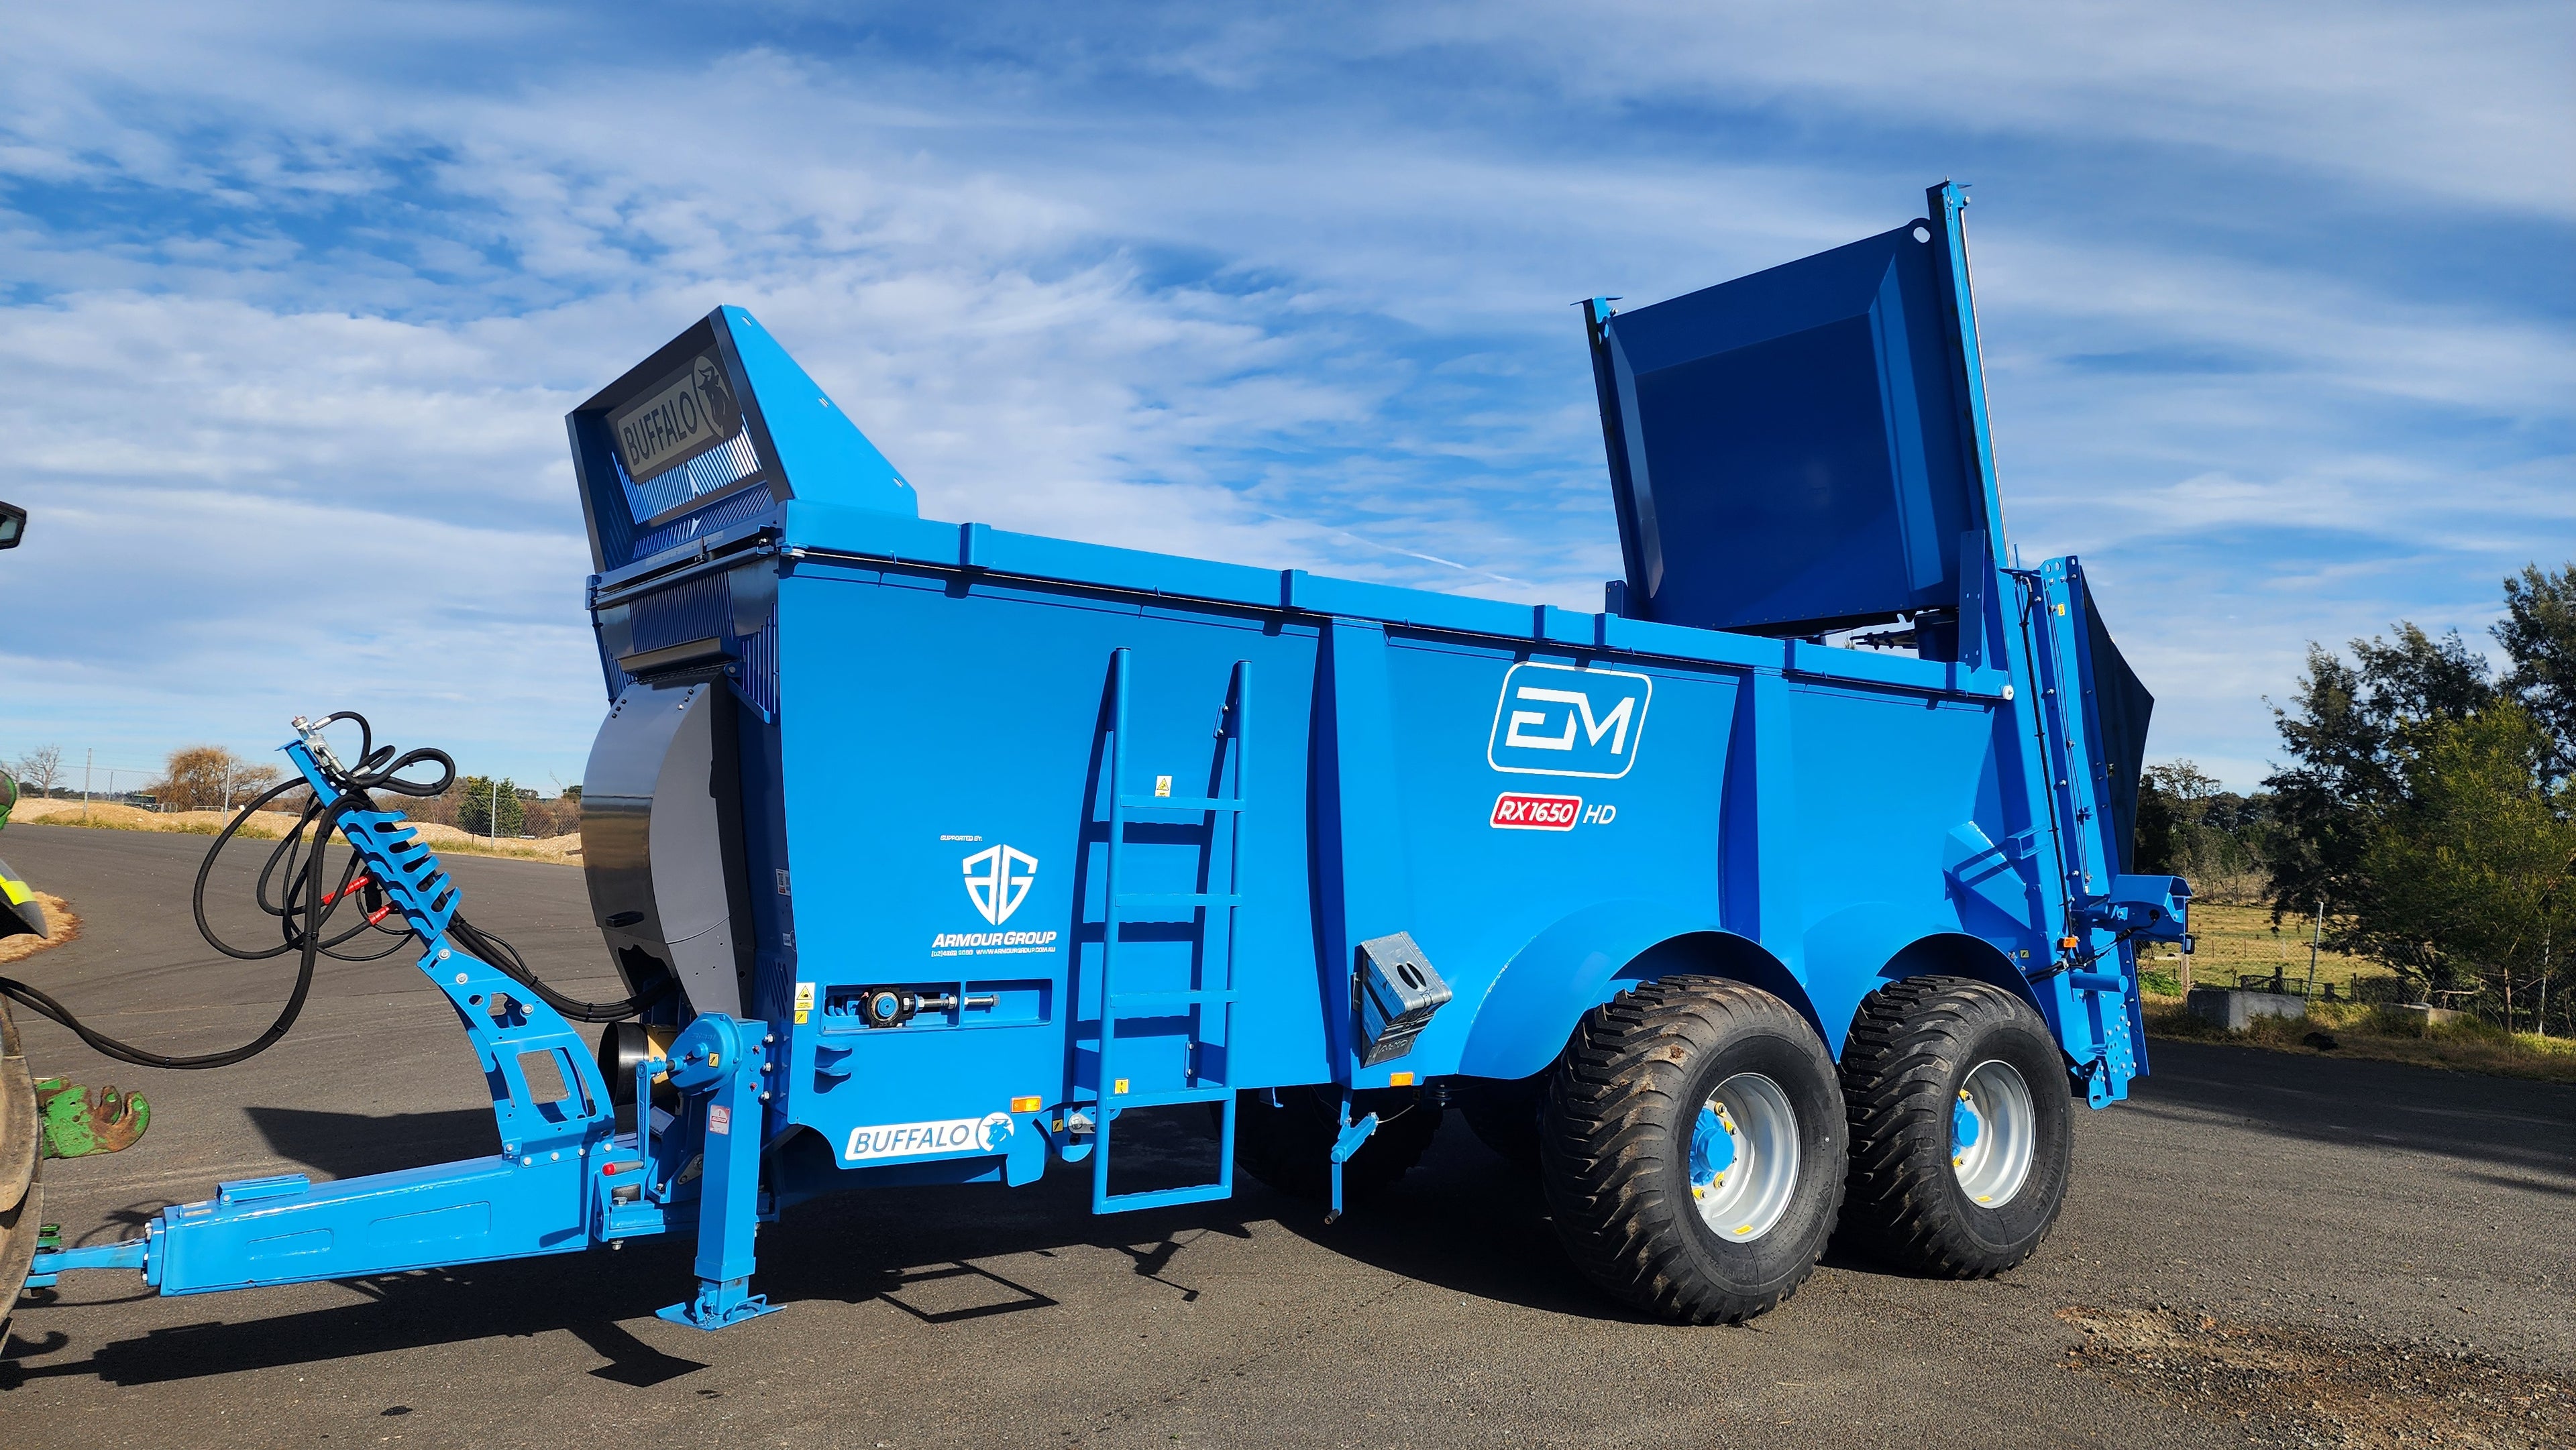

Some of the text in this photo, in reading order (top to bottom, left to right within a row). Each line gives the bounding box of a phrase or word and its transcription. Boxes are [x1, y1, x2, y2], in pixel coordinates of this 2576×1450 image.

[623, 390, 698, 465] BUFFALO
[1498, 799, 1617, 824] RX1650 HD
[854, 1124, 970, 1155] BUFFALO
